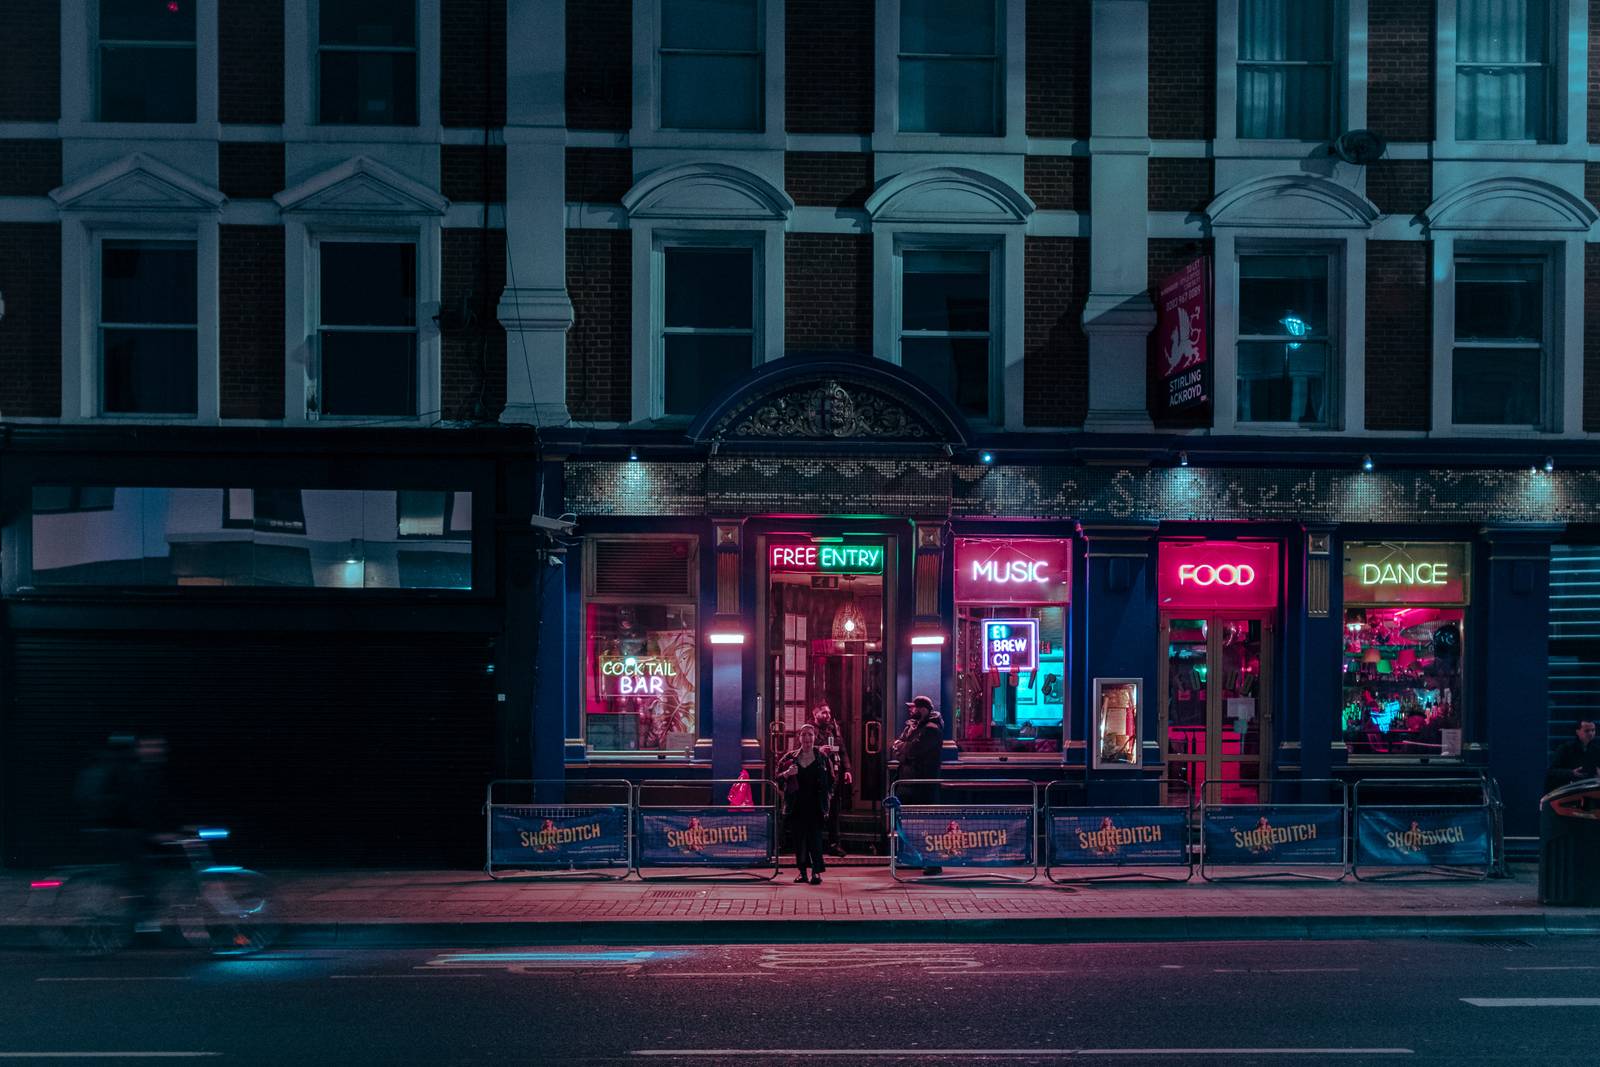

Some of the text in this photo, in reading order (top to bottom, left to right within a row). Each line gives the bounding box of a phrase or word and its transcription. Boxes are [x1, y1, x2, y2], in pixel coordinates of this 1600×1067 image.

[1169, 369, 1201, 392] STIRLING
[1169, 384, 1202, 407] ACKROYD
[774, 547, 881, 568] FREE ENTRY
[972, 560, 1049, 583] MUSIC
[1177, 563, 1255, 586] FOOD
[1364, 563, 1448, 585] DANCE
[993, 625, 1007, 639] E1
[993, 639, 1027, 652] BREW
[619, 675, 664, 695] BAR
[520, 823, 601, 848] SHOREDITCH
[666, 825, 748, 848] SHOREDITCH
[925, 829, 1008, 852] SHOREDITCH
[1079, 825, 1163, 849] SHOREDITCH
[1234, 823, 1317, 848] SHOREDITCH
[1385, 825, 1465, 849] SHOREDITCH
